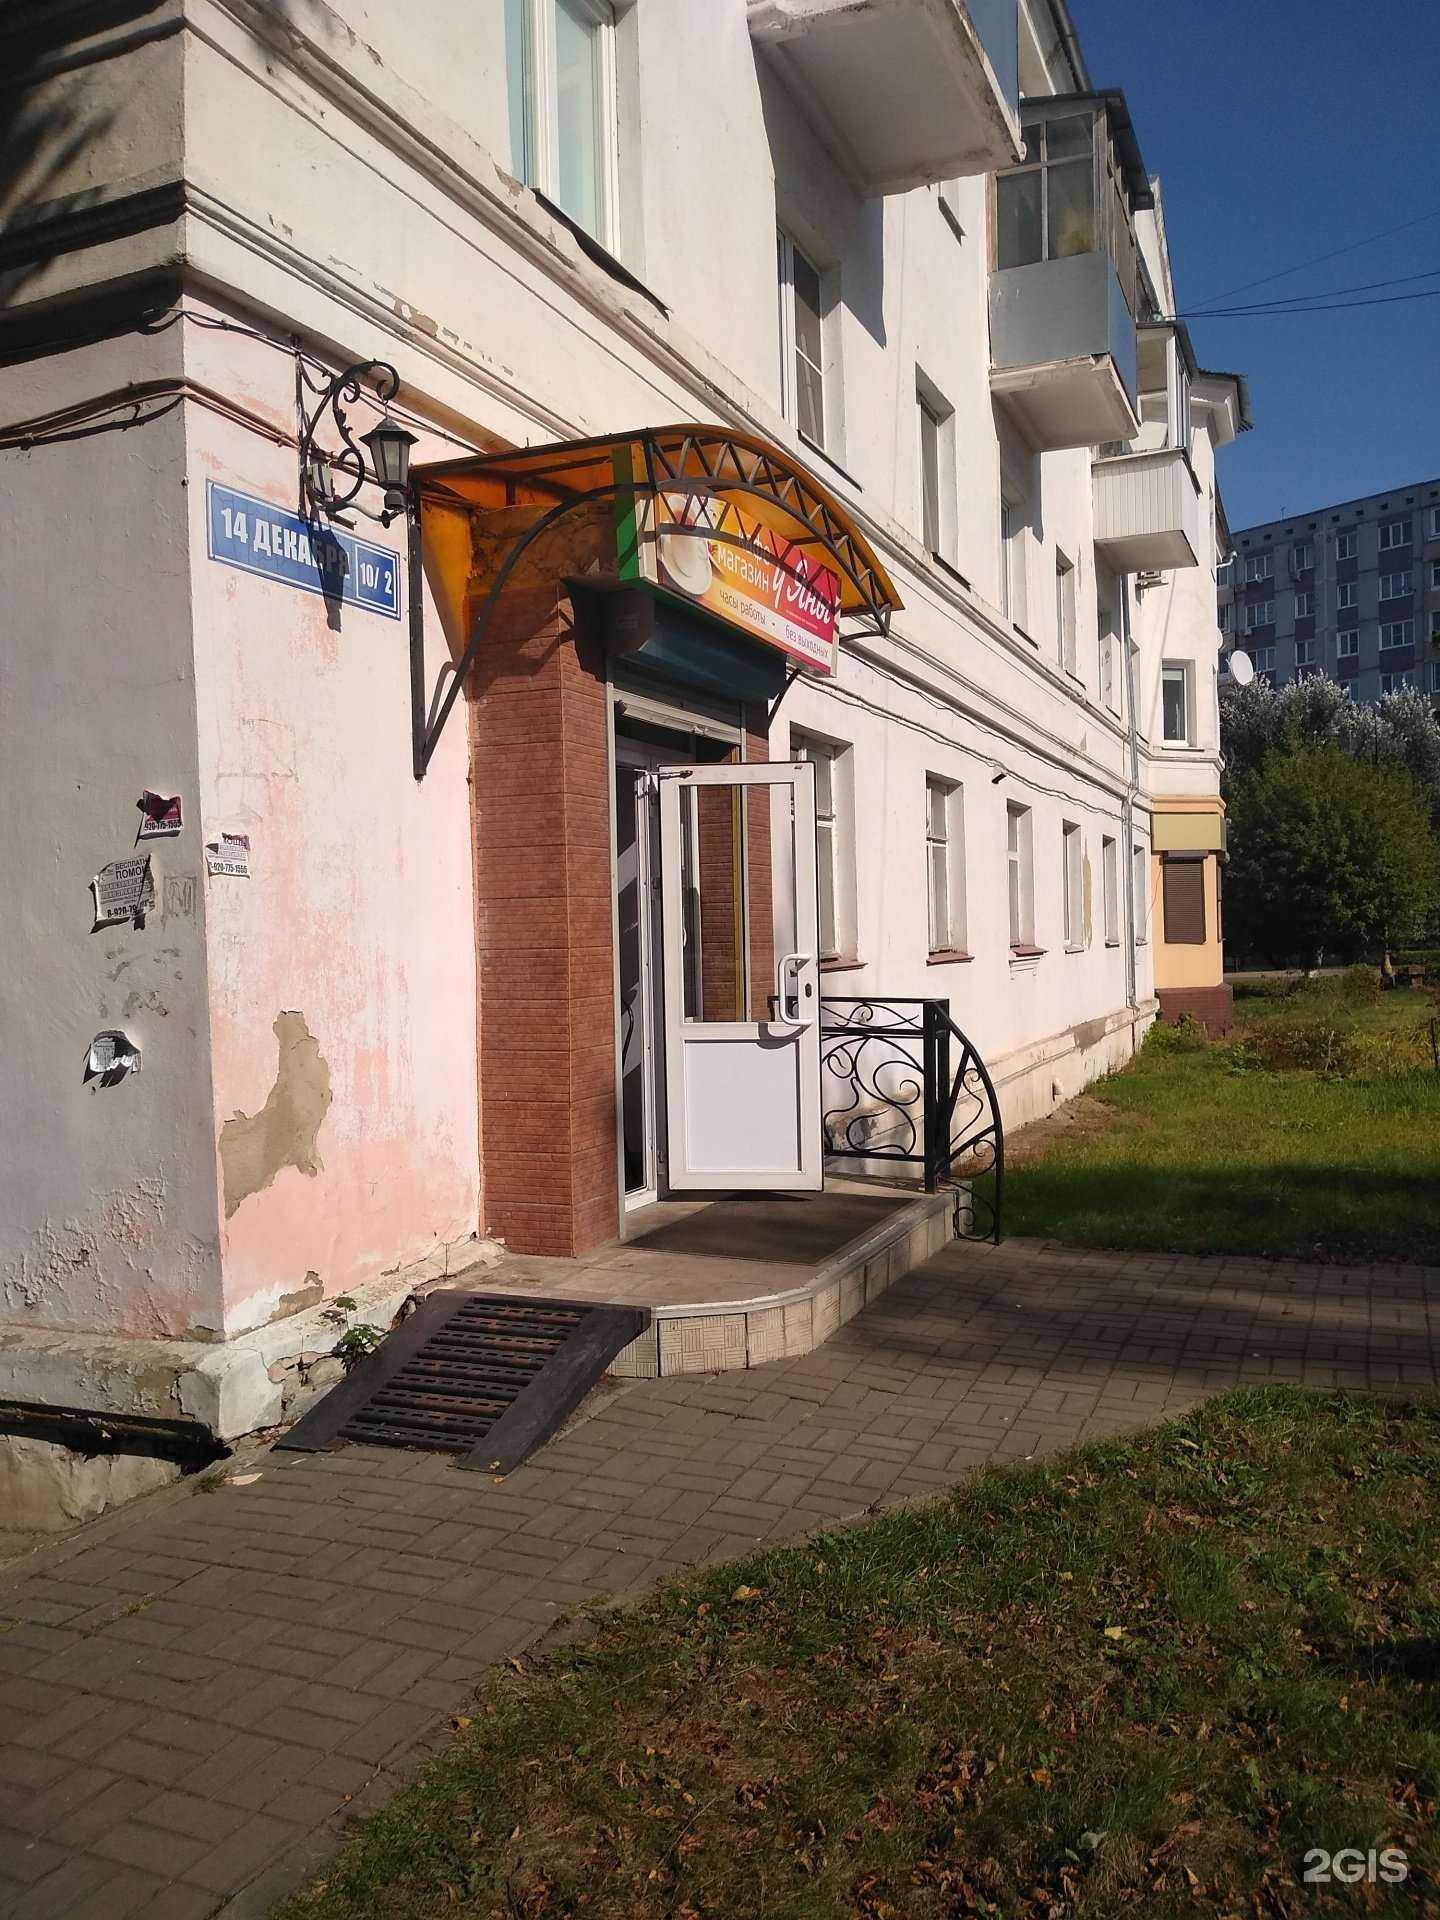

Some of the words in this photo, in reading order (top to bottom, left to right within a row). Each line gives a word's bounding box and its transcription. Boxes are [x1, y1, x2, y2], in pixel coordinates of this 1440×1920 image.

[221, 507, 249, 544] 14
[253, 518, 350, 580] ДЕКАБРЯ
[717, 545, 769, 593] магазин
[719, 590, 739, 610] часы
[739, 599, 767, 625] работы
[784, 623, 797, 642] без
[797, 635, 829, 659] выходных
